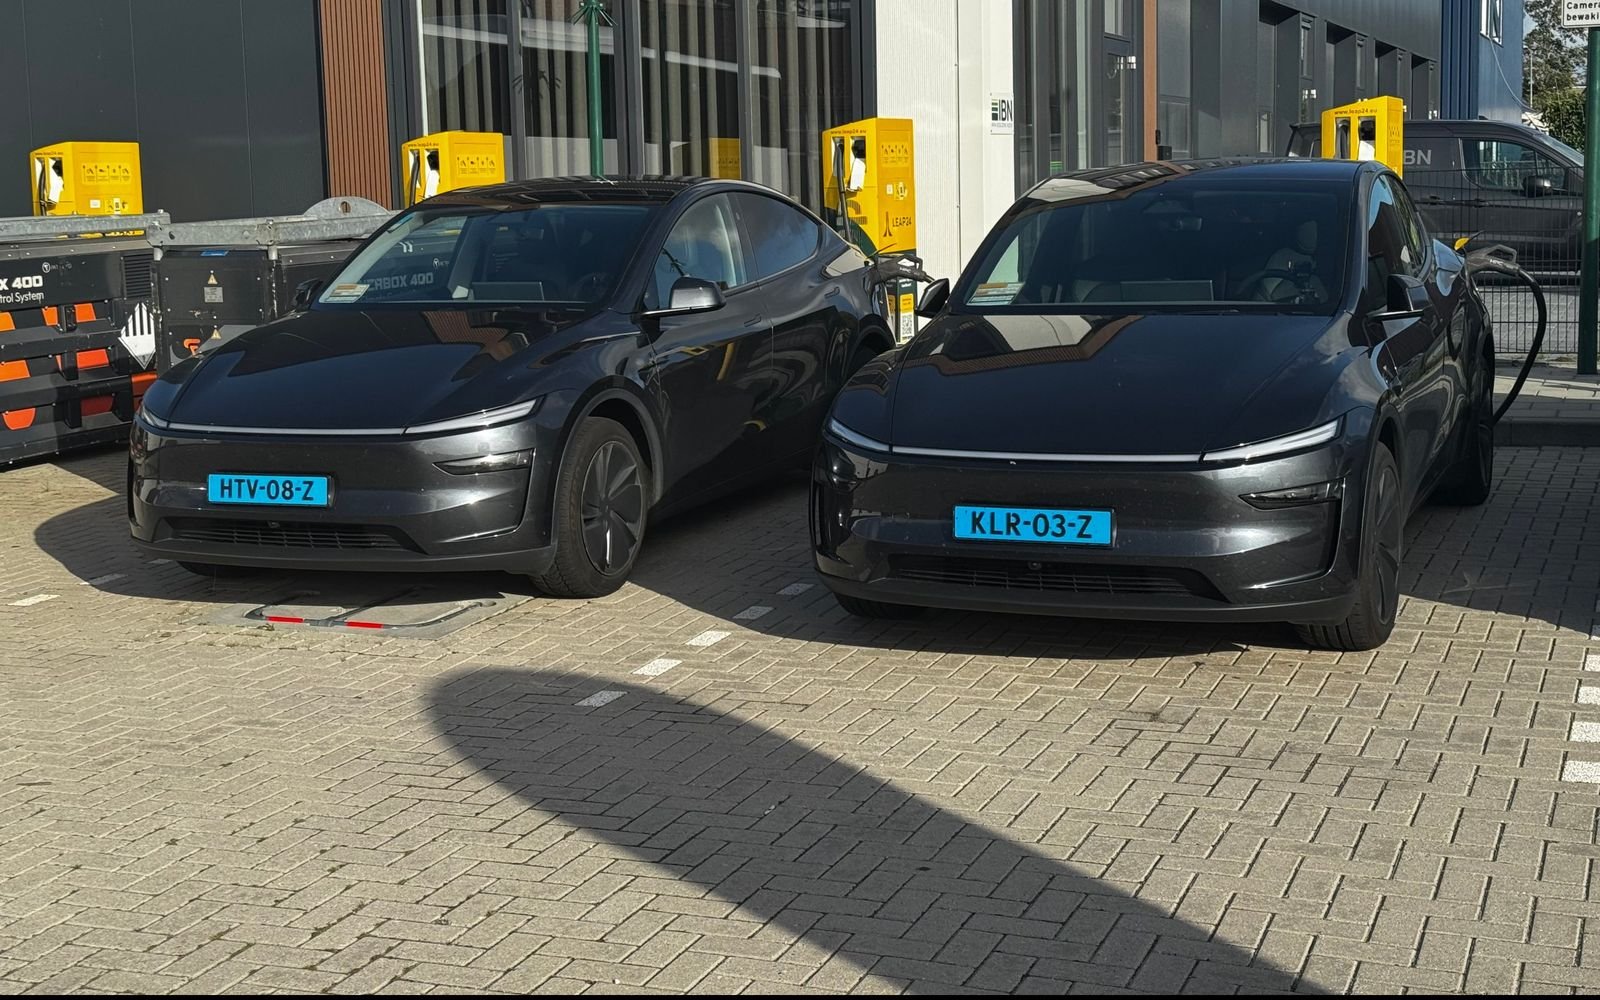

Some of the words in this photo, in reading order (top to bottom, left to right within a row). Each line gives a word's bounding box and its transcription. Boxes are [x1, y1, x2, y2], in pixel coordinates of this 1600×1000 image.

[998, 99, 1013, 121] IBN
[892, 216, 912, 228] LEAP24
[11, 275, 43, 290] 400
[410, 272, 434, 286] 400
[15, 291, 45, 304] System
[220, 478, 314, 501] HTV-08-Z
[971, 510, 1093, 539] KLR-03-Z
